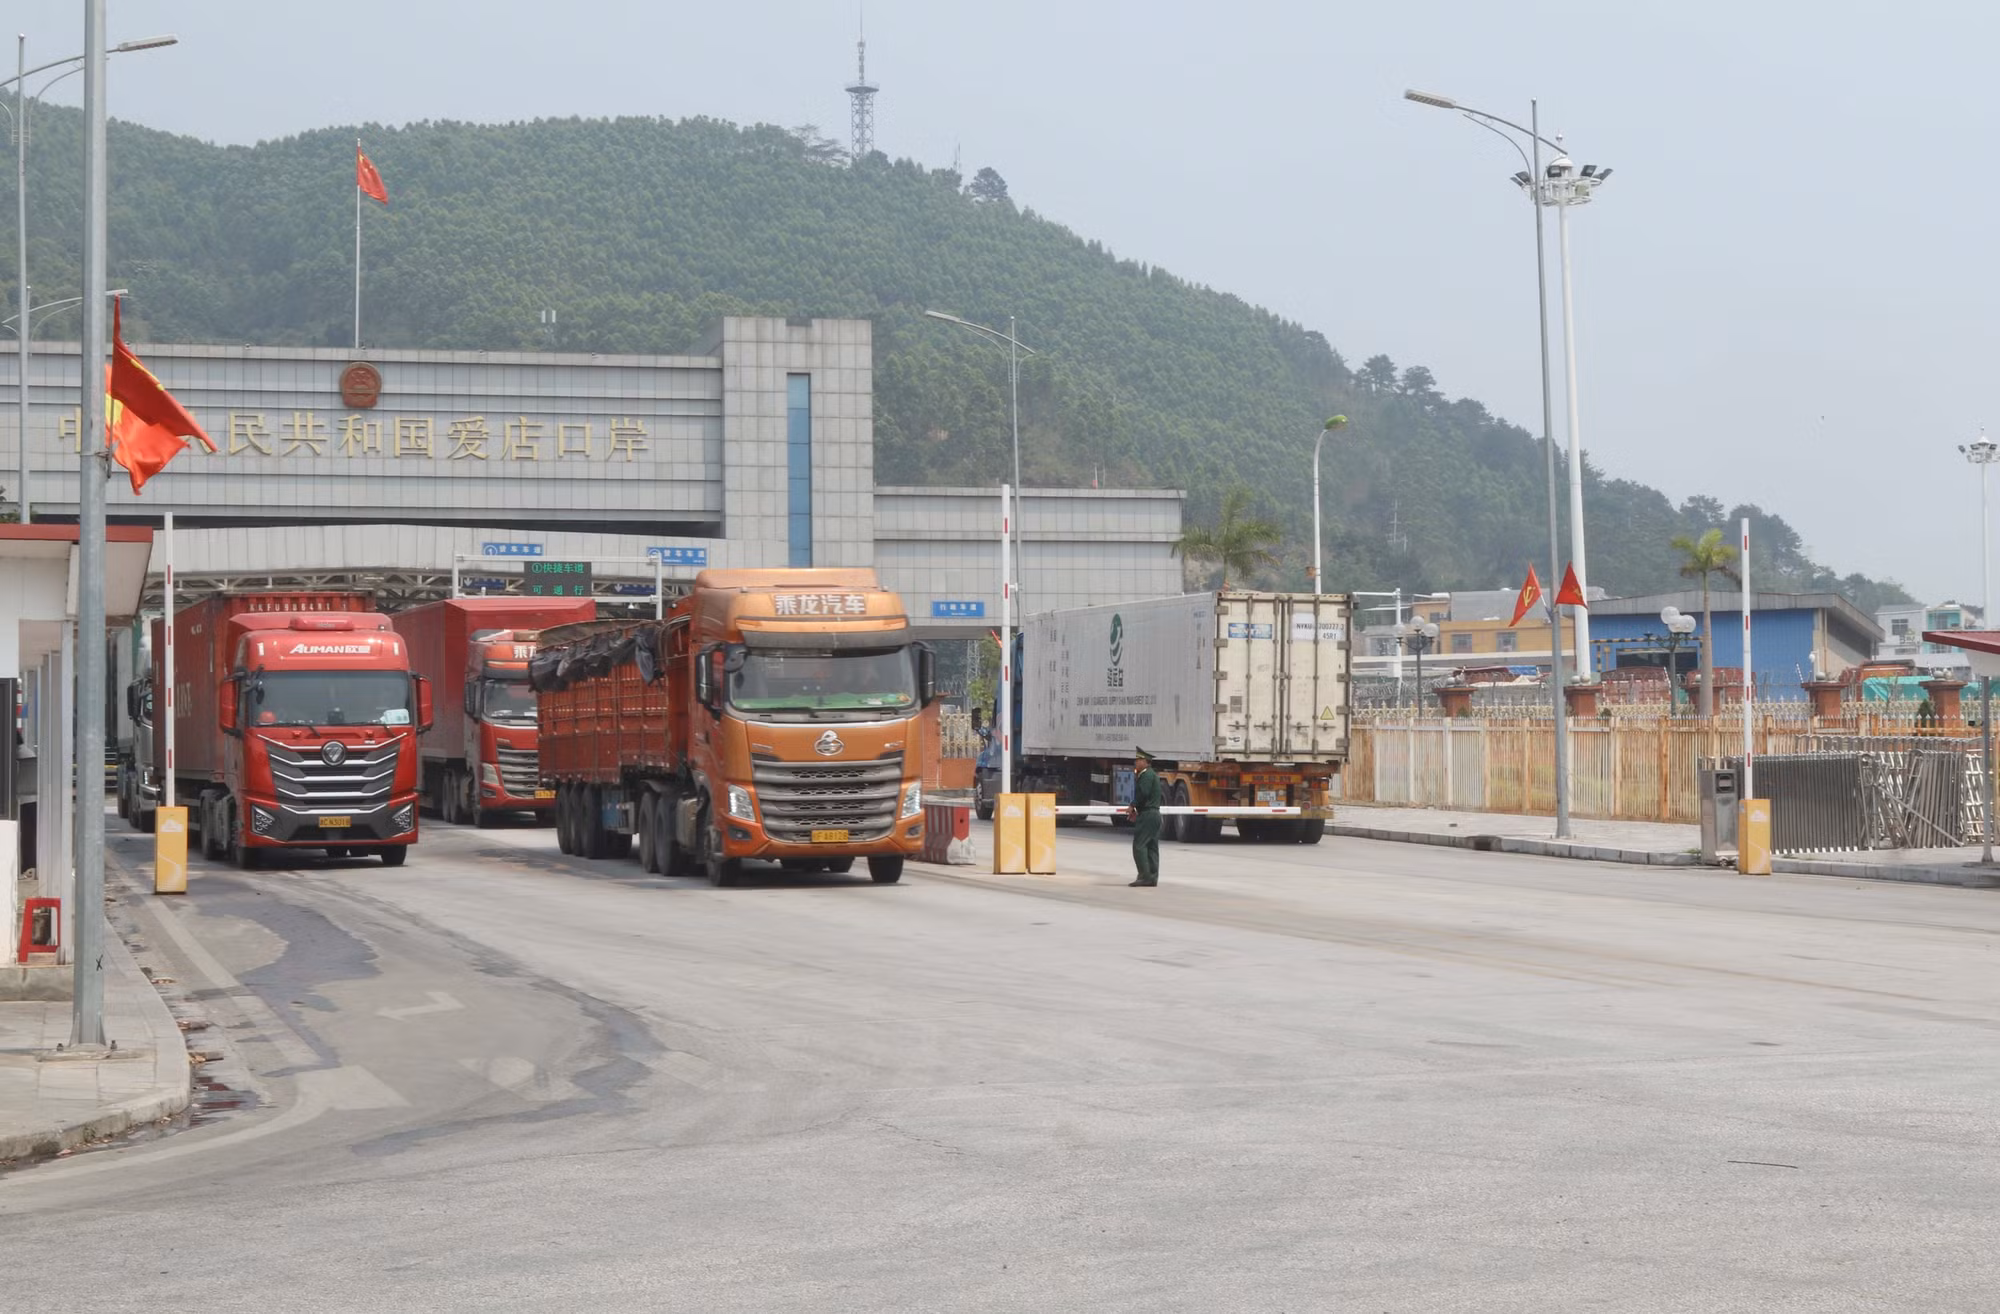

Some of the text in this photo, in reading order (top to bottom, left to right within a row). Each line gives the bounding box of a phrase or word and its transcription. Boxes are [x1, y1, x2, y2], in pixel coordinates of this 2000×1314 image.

[58, 408, 648, 461] 中民共和国爱店口岸
[775, 594, 866, 615] 乘龙汽车
